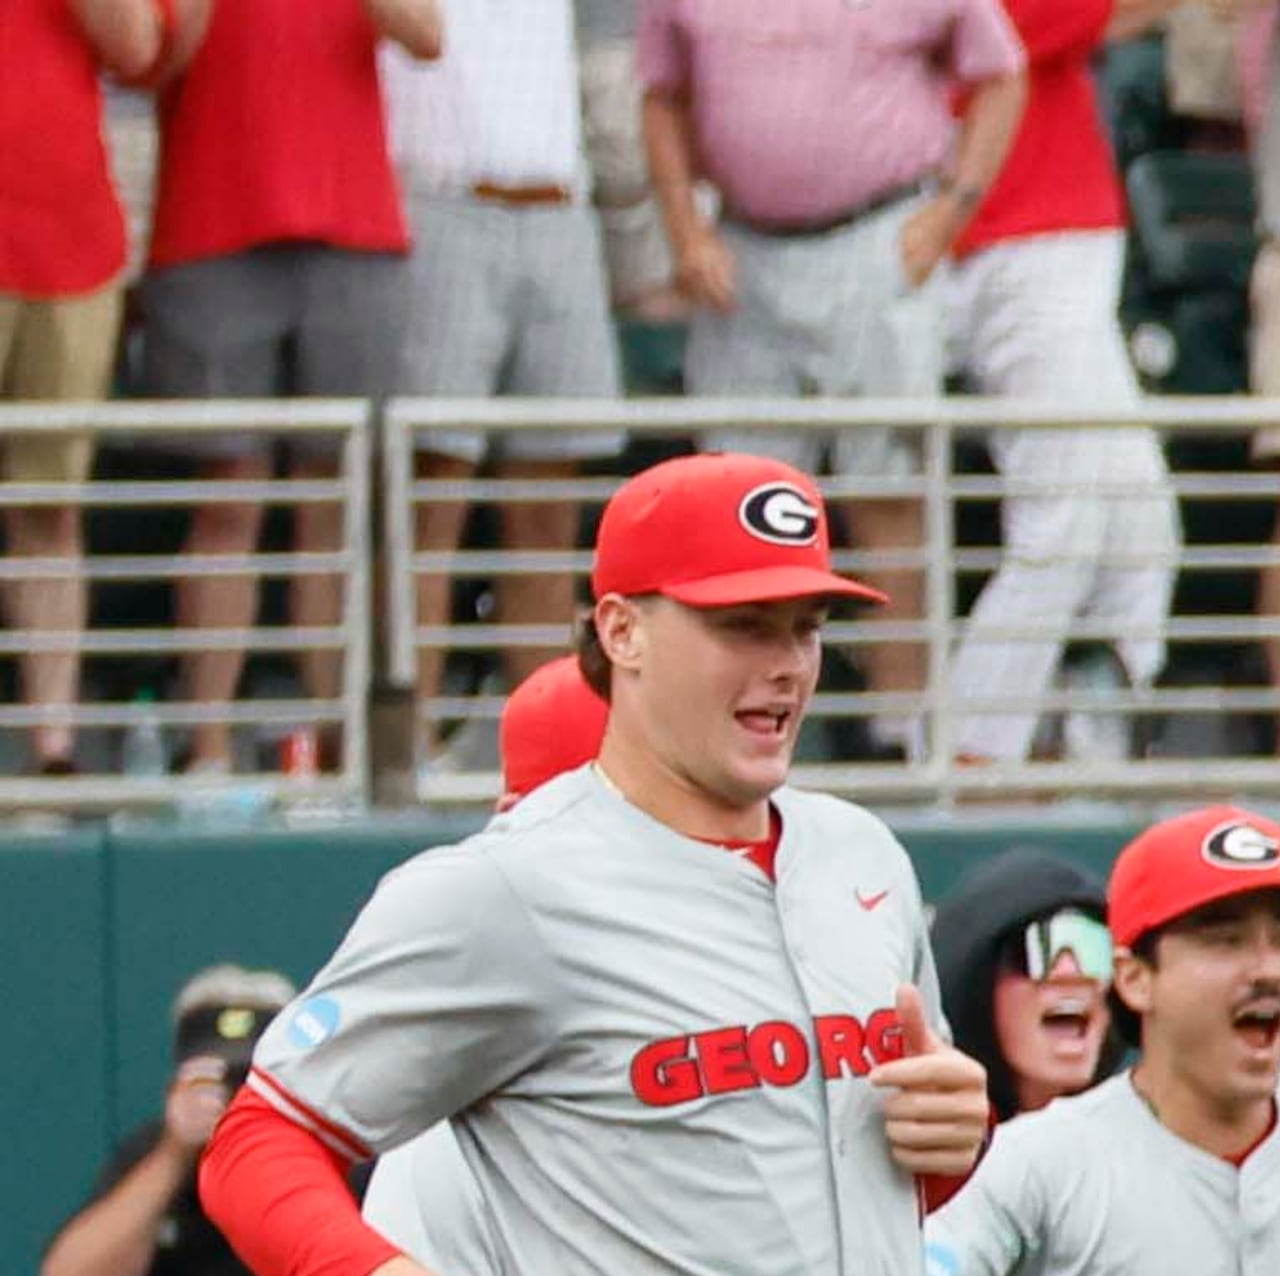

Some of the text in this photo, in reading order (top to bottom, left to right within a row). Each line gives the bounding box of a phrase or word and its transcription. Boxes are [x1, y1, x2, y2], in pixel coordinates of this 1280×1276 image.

[742, 485, 818, 543] G
[1204, 822, 1280, 866] G
[630, 1008, 906, 1108] GEORG
